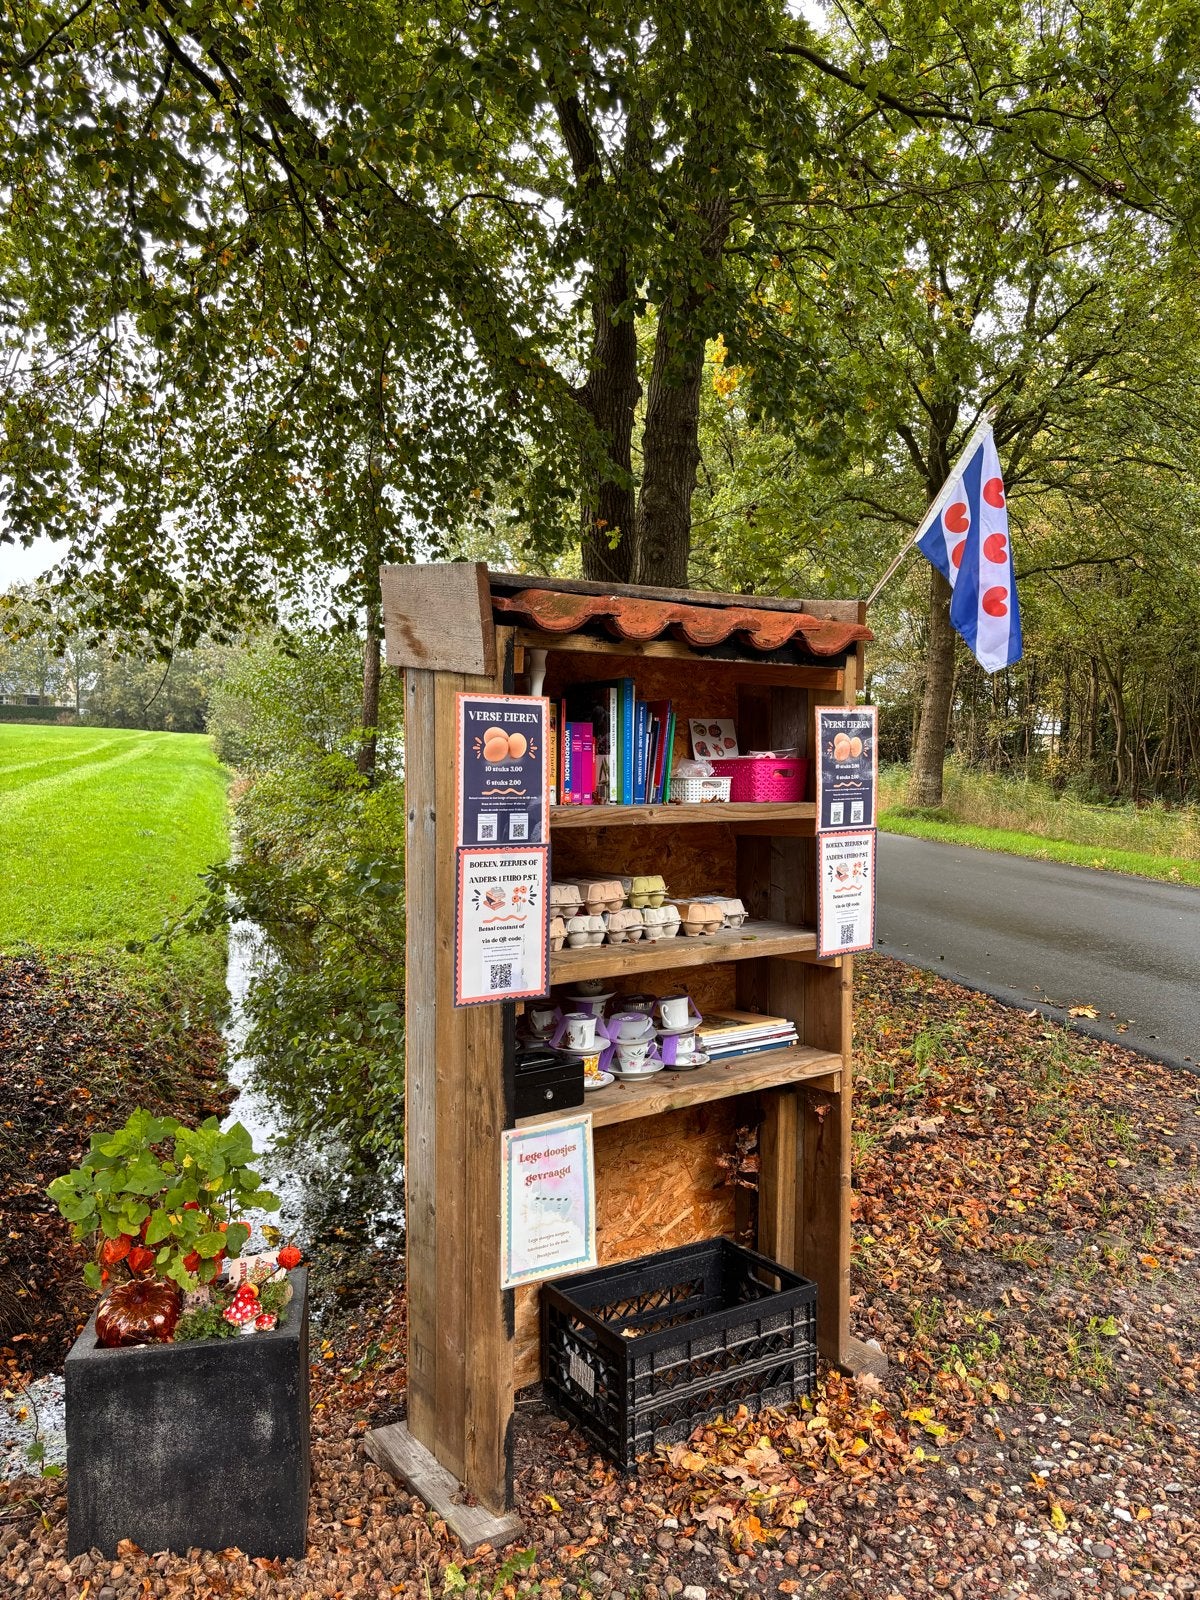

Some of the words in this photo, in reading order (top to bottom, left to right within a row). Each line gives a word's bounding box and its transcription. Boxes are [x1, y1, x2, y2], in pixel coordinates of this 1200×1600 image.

[468, 710, 502, 722] VERSE
[504, 712, 538, 723] EIEREN
[824, 720, 846, 728] VERSE
[847, 720, 870, 729] EIEREN
[520, 1152, 542, 1164] Lege
[544, 1144, 577, 1158] doosjes
[525, 1165, 571, 1187] gevraagd
